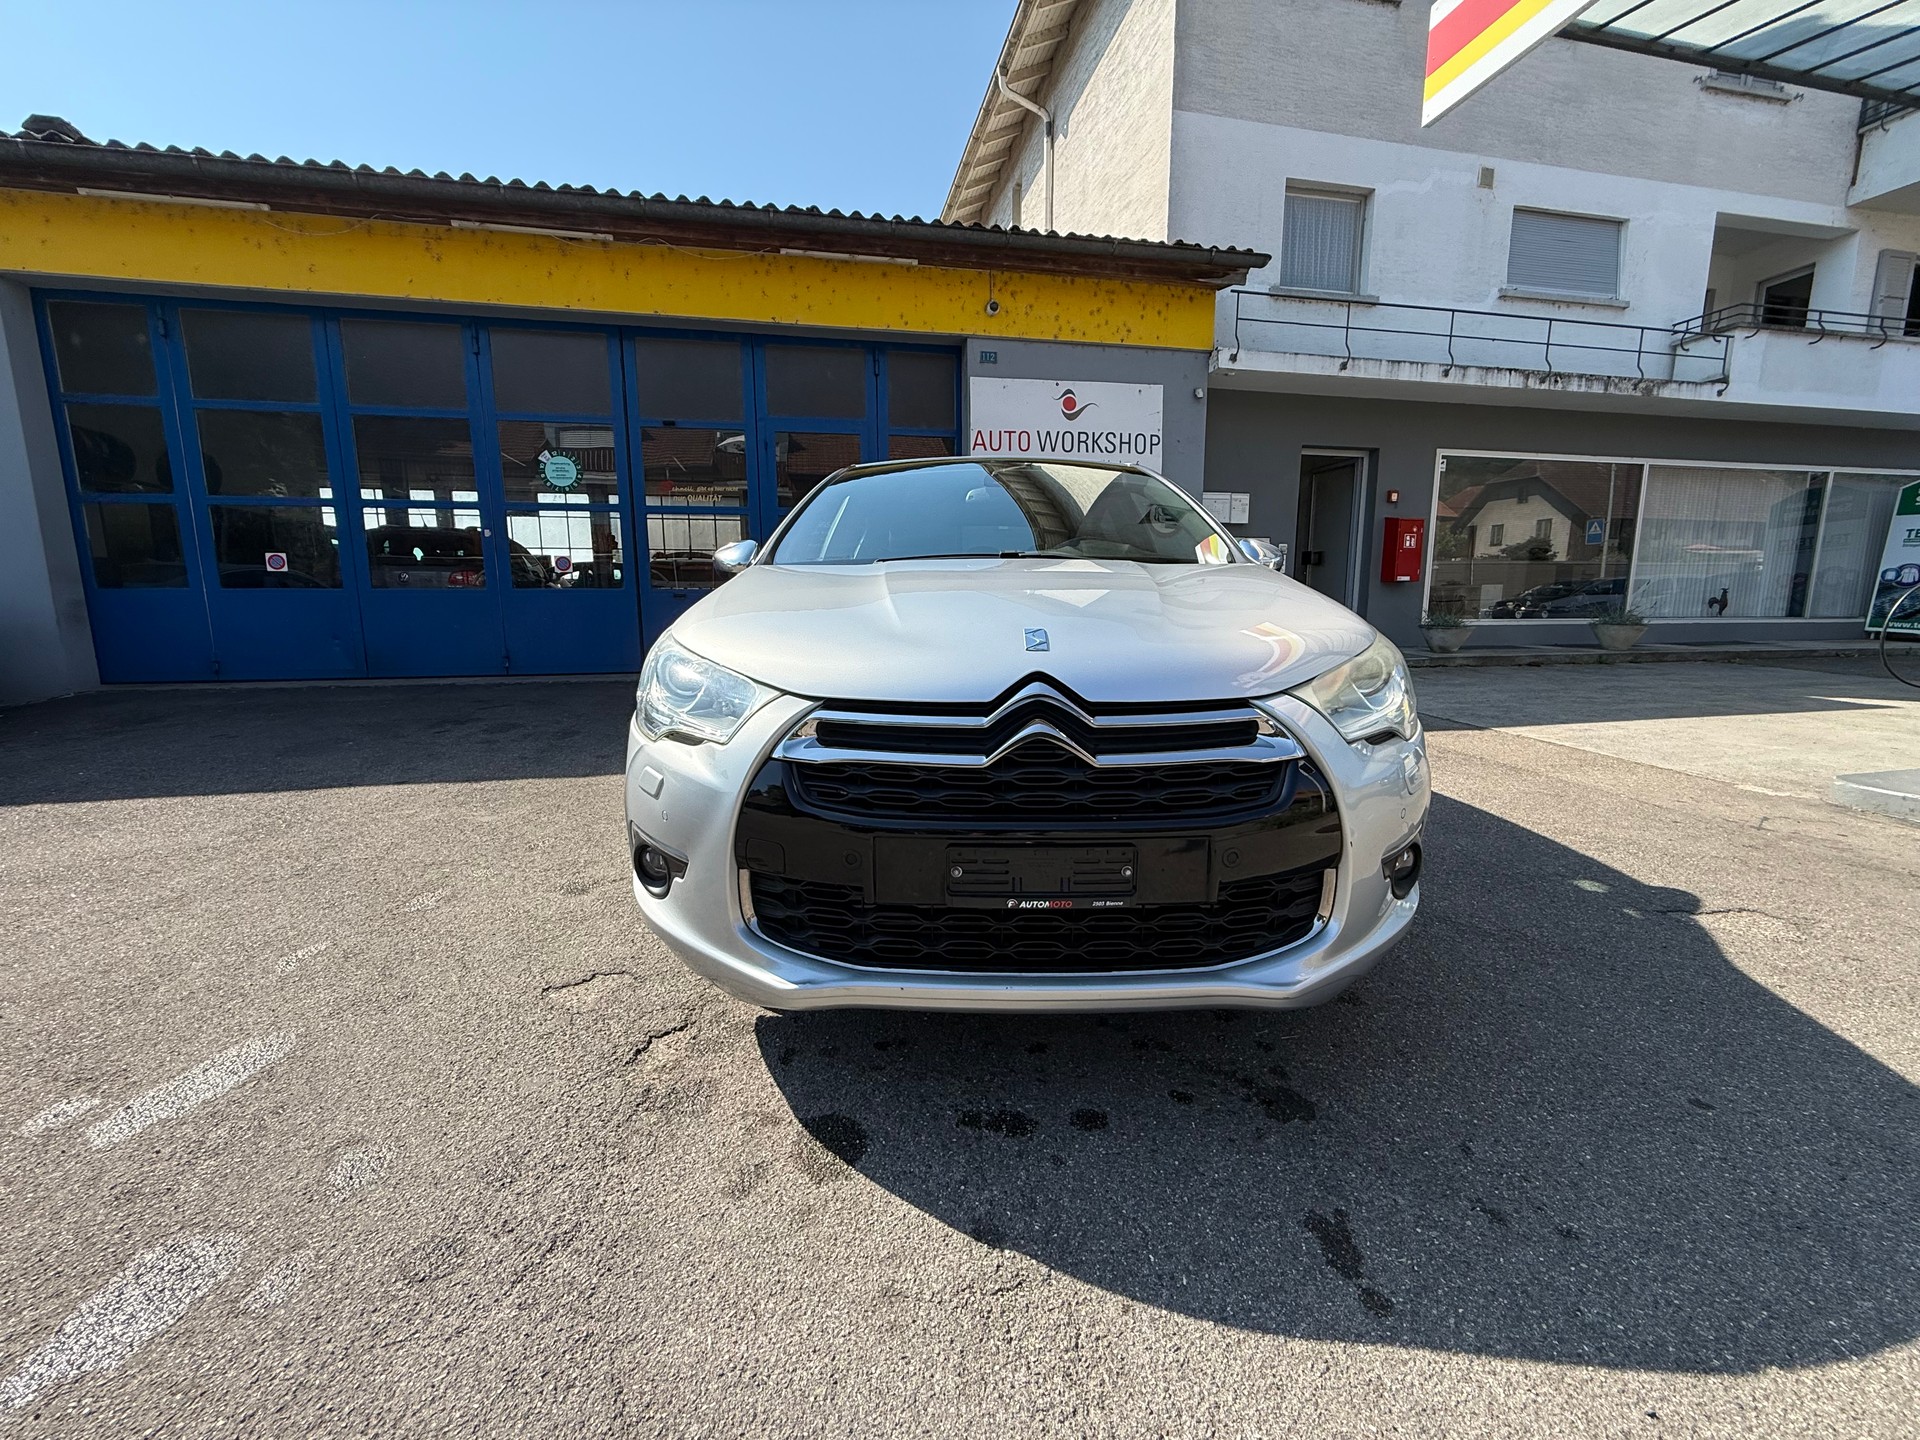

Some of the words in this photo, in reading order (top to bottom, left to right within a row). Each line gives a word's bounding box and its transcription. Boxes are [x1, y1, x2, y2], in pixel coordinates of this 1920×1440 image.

[983, 352, 995, 361] 112
[972, 430, 1031, 452] AUTO
[1037, 430, 1161, 455] WORKSHOP
[1019, 900, 1073, 909] AUTOMOTO
